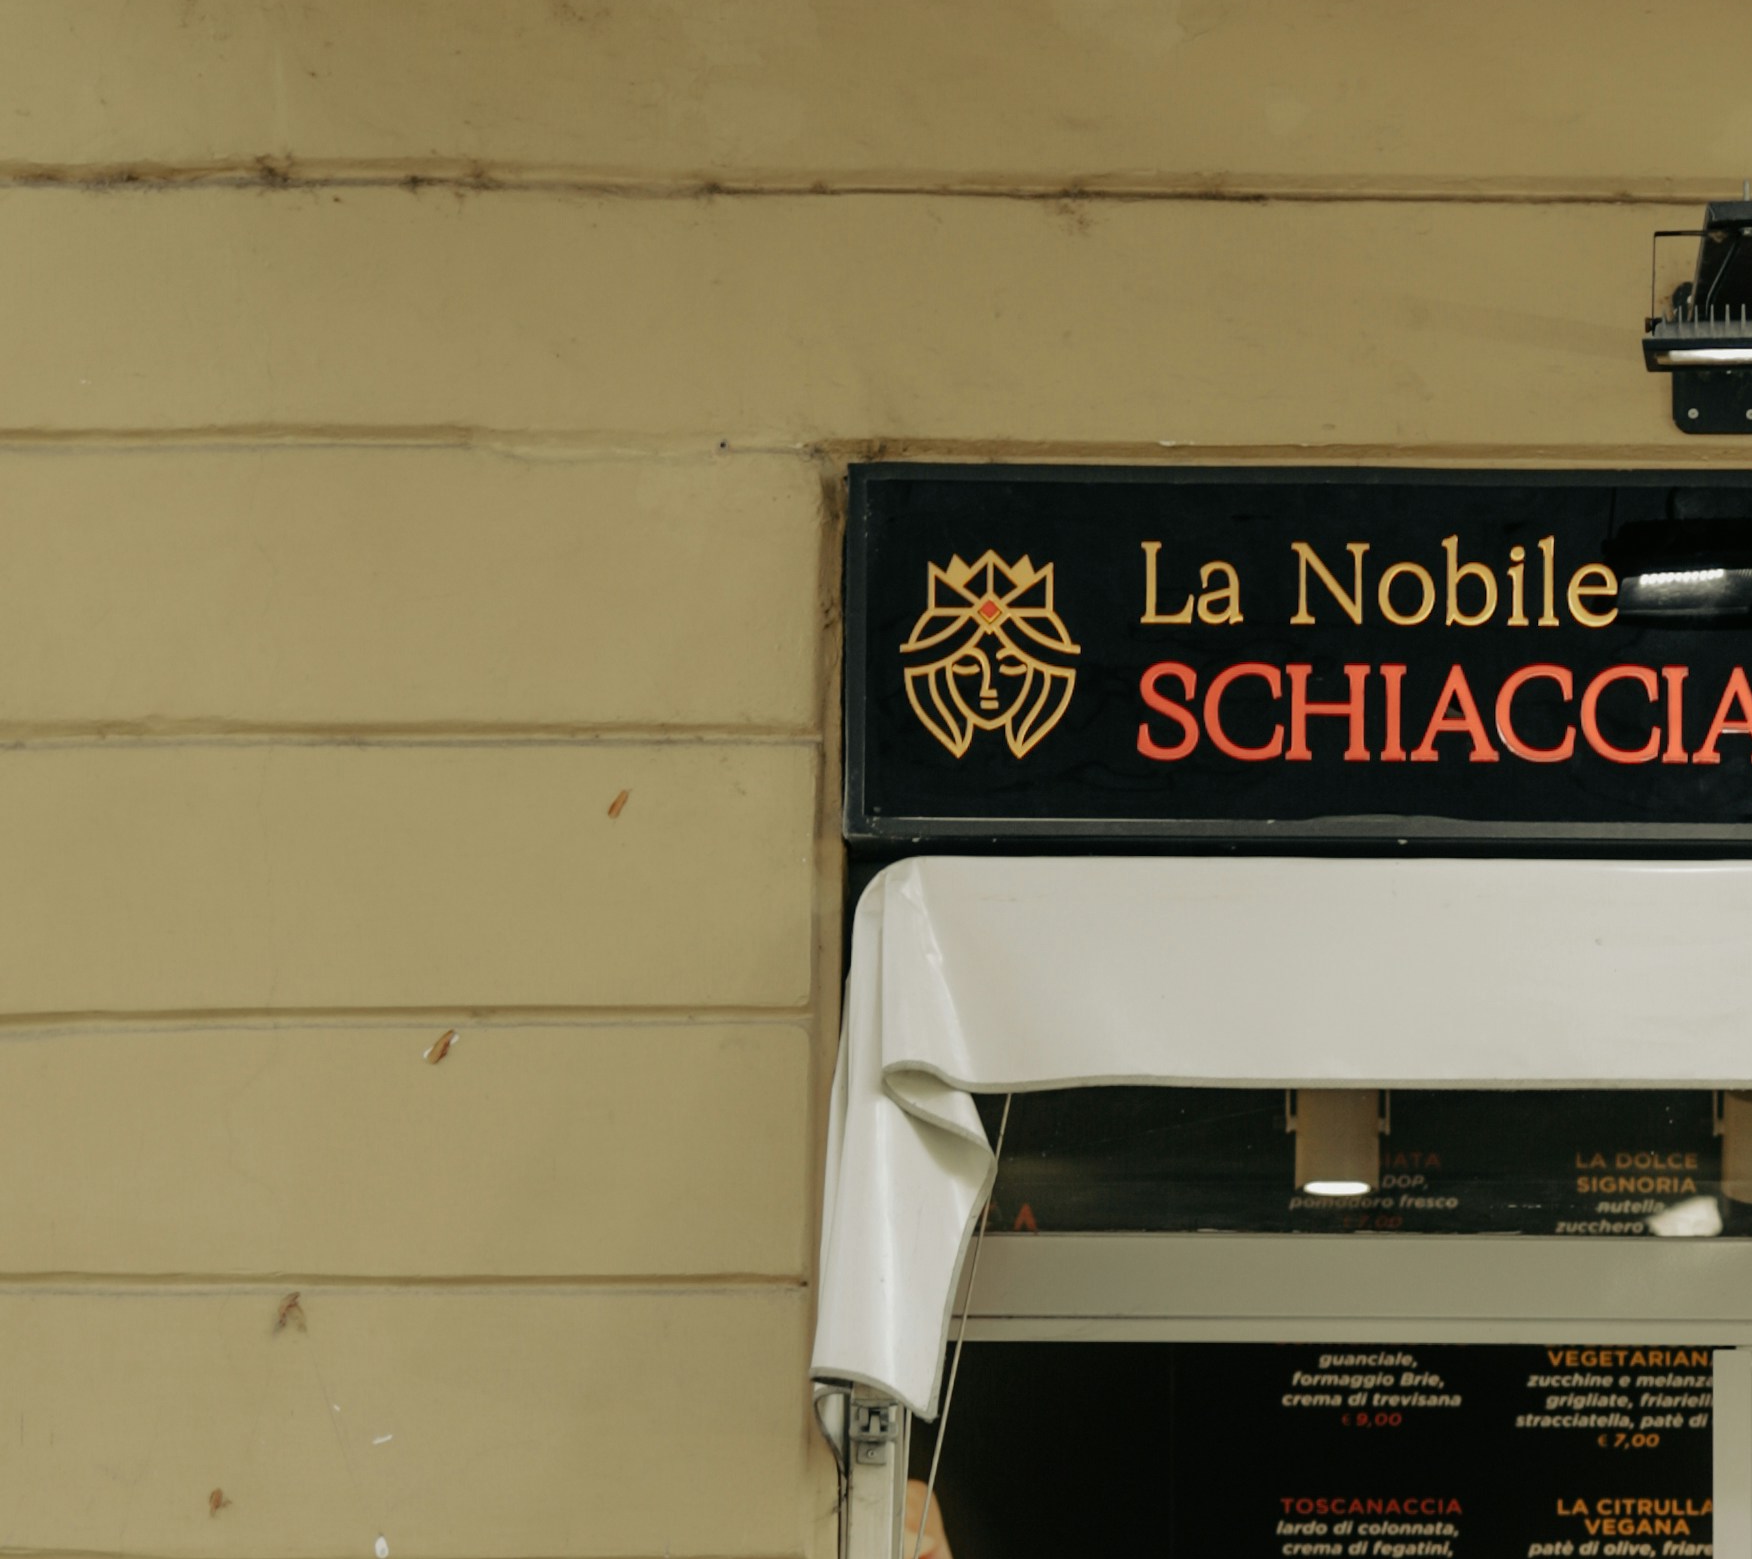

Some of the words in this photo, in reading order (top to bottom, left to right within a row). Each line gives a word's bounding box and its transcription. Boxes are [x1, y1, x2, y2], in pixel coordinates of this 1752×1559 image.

[1141, 541, 1245, 628] La
[1291, 535, 1619, 628] Nobile
[1575, 1151, 1606, 1169] LA
[1616, 1151, 1698, 1170] DOLCE
[1577, 1176, 1697, 1193] SIGNORIA
[1289, 1195, 1393, 1211] pomodoro
[1399, 1194, 1458, 1209] fresco
[1555, 1219, 1644, 1234] zucchero
[1318, 1351, 1418, 1369] guanciale,
[1548, 1350, 1713, 1367] VEGETARIAN
[1292, 1371, 1395, 1389] formaggio
[1399, 1371, 1445, 1388] Brie,
[1527, 1372, 1613, 1387] zucchine
[1618, 1375, 1631, 1387] e
[1281, 1393, 1342, 1407] crema
[1347, 1391, 1368, 1407] di
[1372, 1392, 1462, 1407] trevisana
[1545, 1393, 1634, 1410] grigliate,
[1515, 1412, 1635, 1429] stracciatella,
[1640, 1412, 1685, 1430] patè
[1688, 1413, 1708, 1428] di
[1280, 1497, 1463, 1515] TOSCANACCIA
[1557, 1498, 1589, 1516] LA
[1596, 1498, 1713, 1516] CITRULLA
[1276, 1520, 1329, 1536] lardo
[1333, 1520, 1353, 1536] di
[1357, 1520, 1460, 1538] colonnata,
[1584, 1518, 1691, 1536] VEGANA
[1282, 1542, 1342, 1556] crema
[1347, 1540, 1368, 1556] di
[1372, 1540, 1454, 1559] fegatini,
[1527, 1541, 1574, 1558] patè
[1579, 1541, 1599, 1556] di
[1603, 1541, 1657, 1558] olive,
